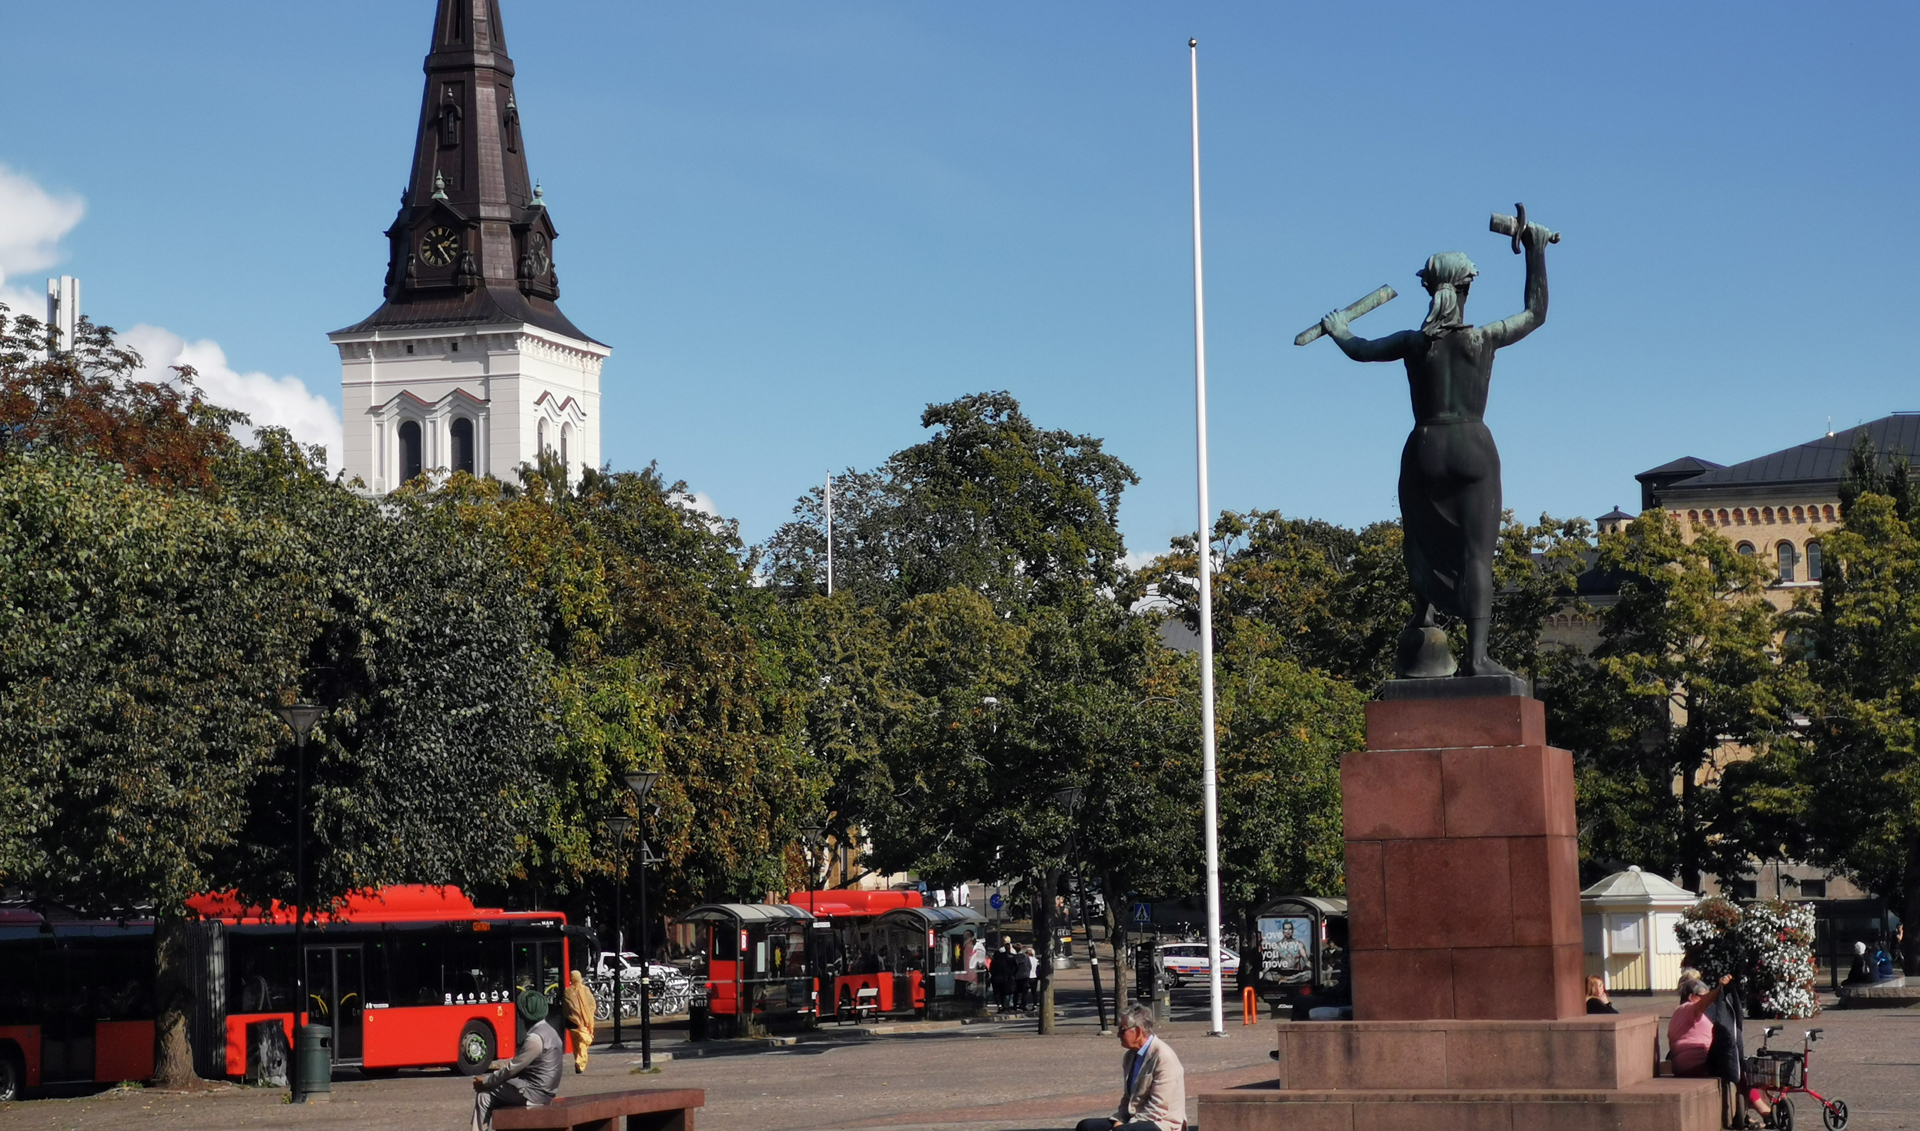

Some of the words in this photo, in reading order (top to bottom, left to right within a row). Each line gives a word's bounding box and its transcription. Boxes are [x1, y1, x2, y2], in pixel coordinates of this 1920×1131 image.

[1262, 932, 1284, 940] Love
[1262, 940, 1278, 950] the
[1279, 941, 1299, 952] way
[1262, 950, 1278, 960] you
[1262, 960, 1288, 968] move
